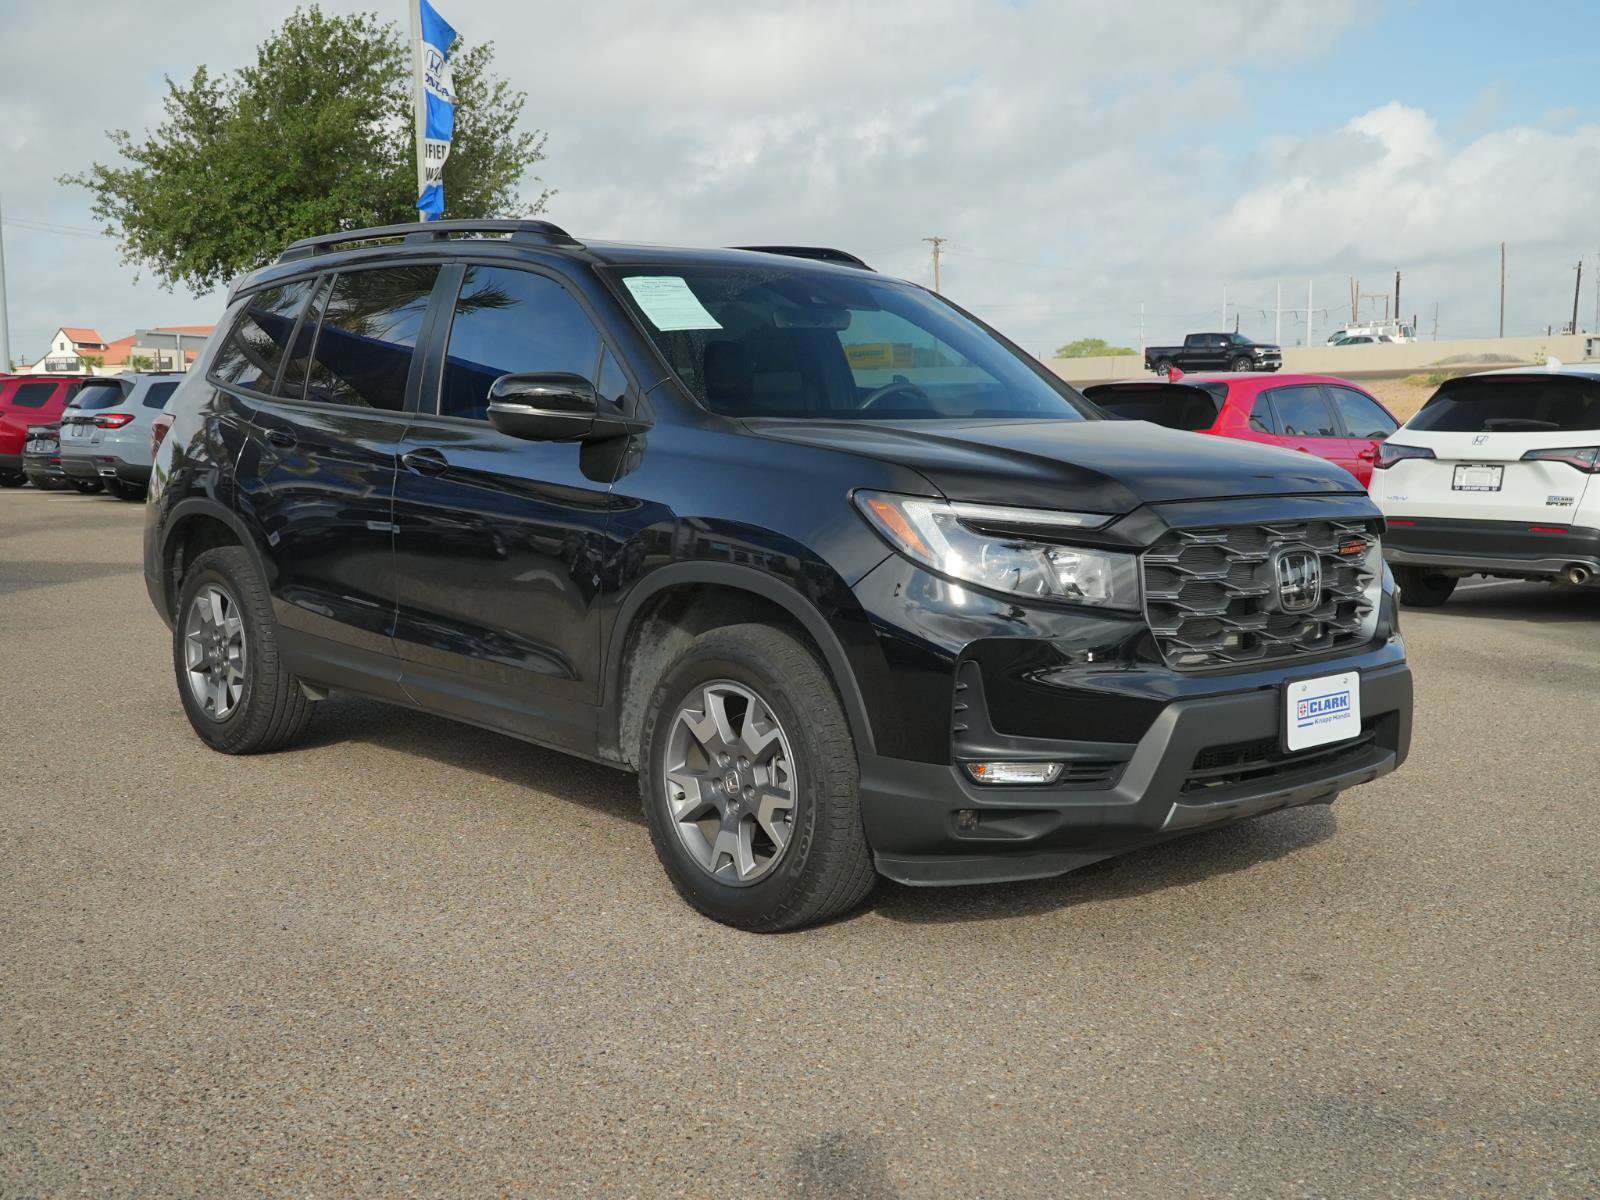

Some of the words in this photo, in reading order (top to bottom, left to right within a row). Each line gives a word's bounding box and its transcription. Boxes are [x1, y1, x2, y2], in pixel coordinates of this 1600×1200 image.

[1310, 696, 1347, 713] CLARK
[1314, 716, 1332, 725] Knapp
[1333, 712, 1351, 720] Honda
